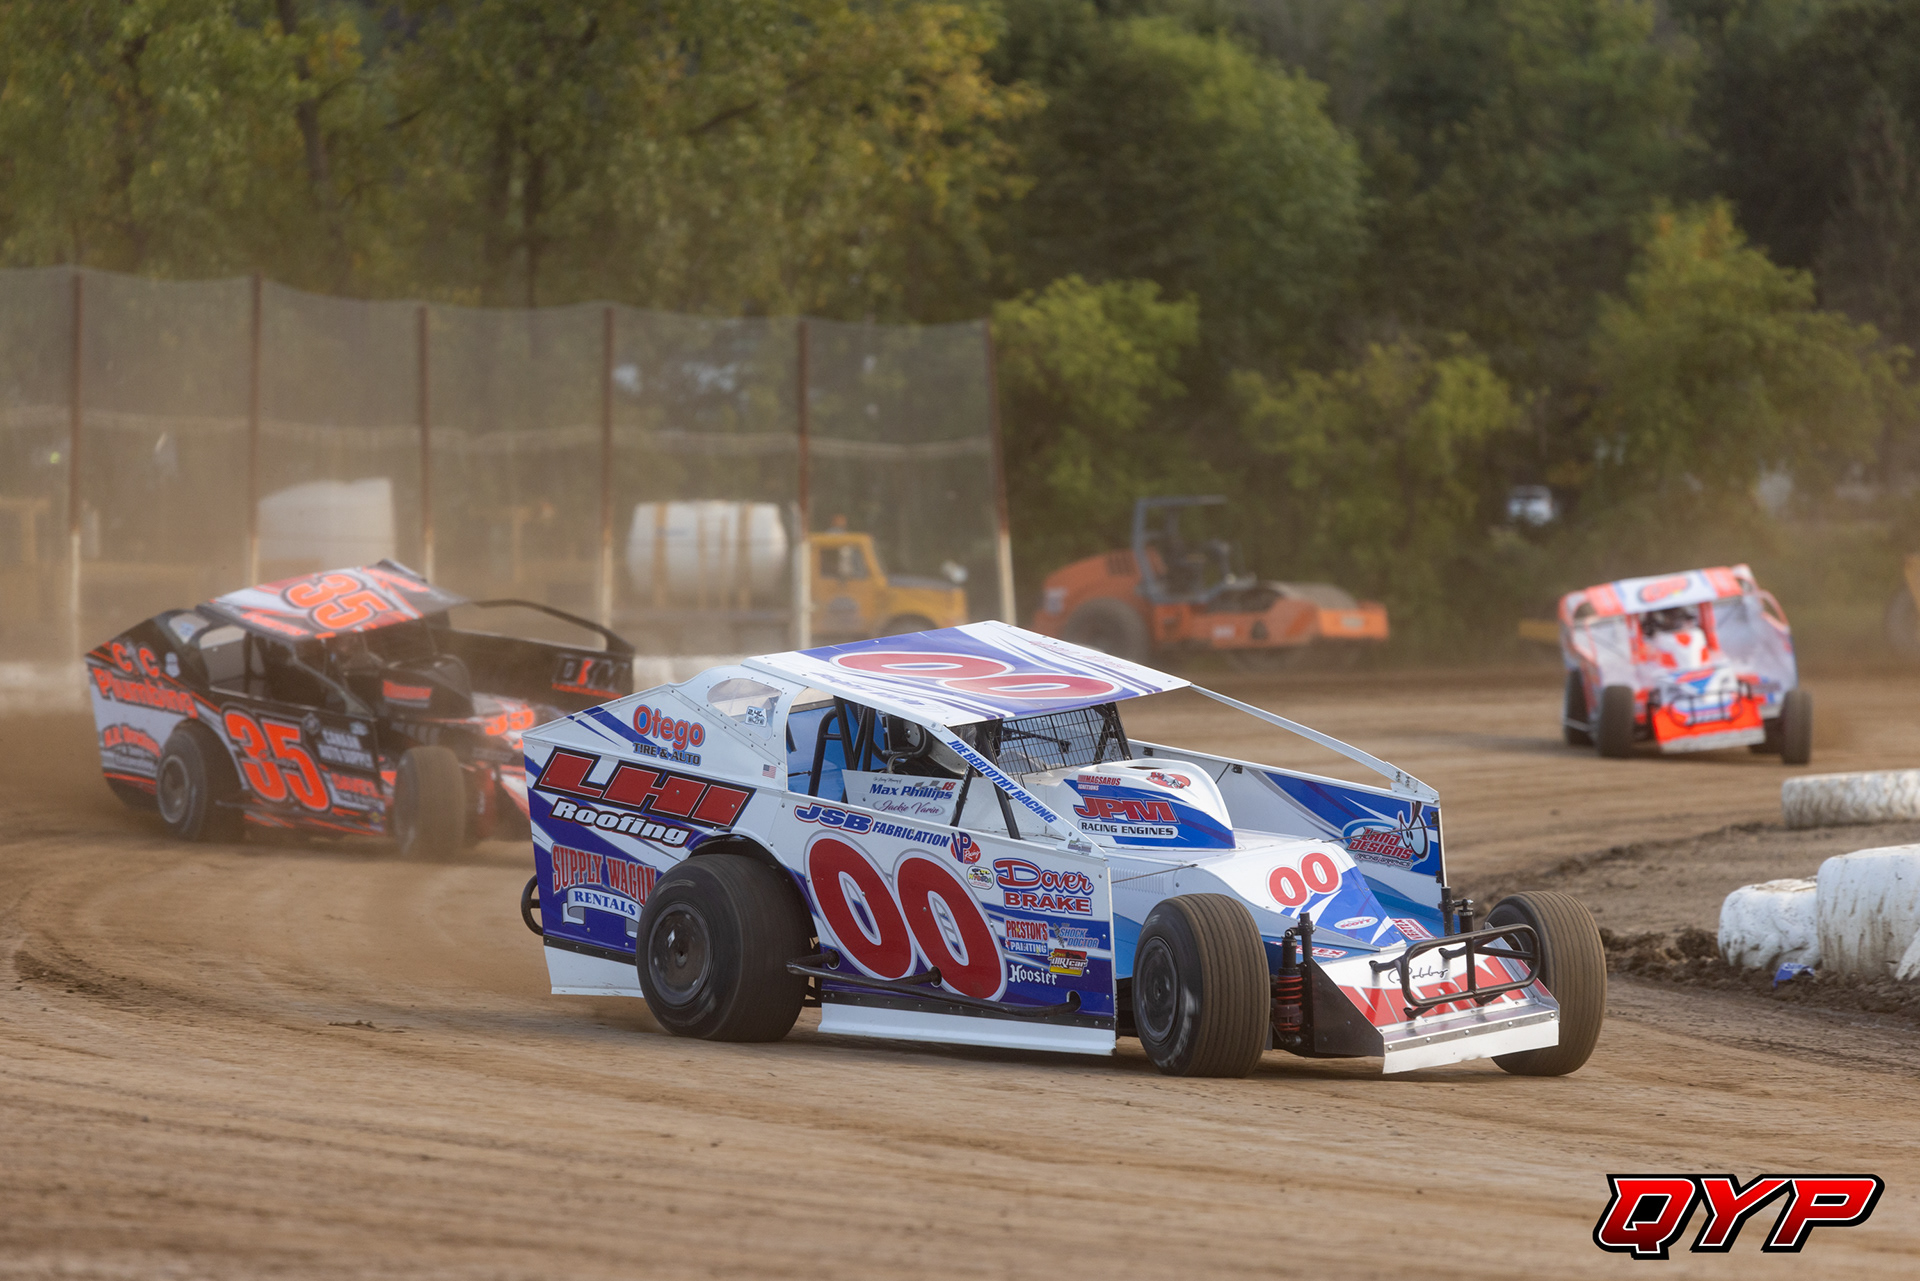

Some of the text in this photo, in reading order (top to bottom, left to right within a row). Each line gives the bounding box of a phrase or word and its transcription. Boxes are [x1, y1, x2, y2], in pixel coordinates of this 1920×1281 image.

[287, 573, 389, 629] 35
[836, 652, 1116, 699] 00
[92, 666, 199, 719] Plumbing
[485, 709, 534, 736] 35
[633, 704, 705, 751] Otego
[225, 712, 329, 810] 35
[633, 742, 702, 766] TIRE & AUTO
[537, 749, 752, 829] LHI
[869, 784, 953, 800] Max Phillips
[941, 781, 956, 791] 18
[947, 740, 1058, 823] JOE BERTOTHY RACING
[1085, 775, 1121, 786] MAGSARUS
[881, 800, 939, 814] Jackie Varin
[1074, 795, 1179, 823] JPM
[551, 799, 693, 846] Roofing
[795, 803, 951, 848] JSB FABRICATION
[1081, 822, 1174, 835] RACING ENGINES
[951, 831, 972, 864] VP
[1348, 839, 1414, 860] DESIGNS
[1361, 828, 1401, 846] LAND
[552, 843, 657, 906] SUPPLY WAGON
[994, 858, 1093, 895] Dover
[1268, 852, 1339, 907] 00
[574, 890, 637, 916] RENTALS
[1004, 890, 1092, 915] BRAKE
[807, 836, 1004, 999] 00
[1005, 920, 1048, 941] PRESTON'S
[1059, 927, 1088, 937] SHOCK
[1067, 938, 1099, 948] DOCTOR
[1010, 941, 1047, 954] PAINTING
[1008, 964, 1058, 985] Hoosier
